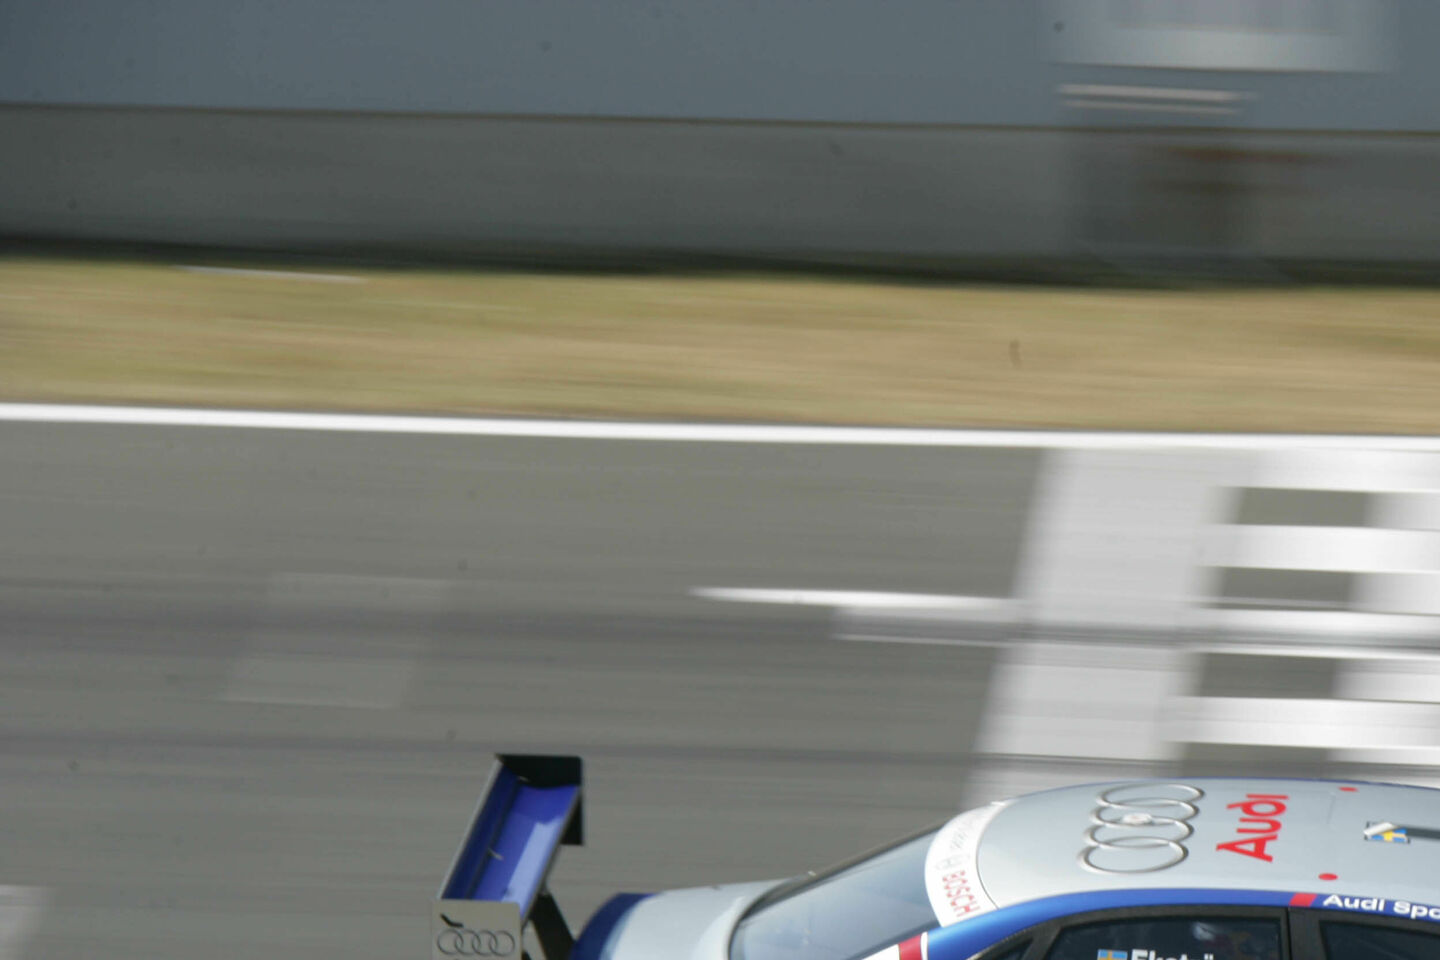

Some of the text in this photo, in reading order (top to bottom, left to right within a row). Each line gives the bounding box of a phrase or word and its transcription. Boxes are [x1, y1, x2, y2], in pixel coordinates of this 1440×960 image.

[1216, 793, 1289, 863] Audi
[942, 869, 981, 918] BOSCH
[1322, 894, 1385, 912] Audi
